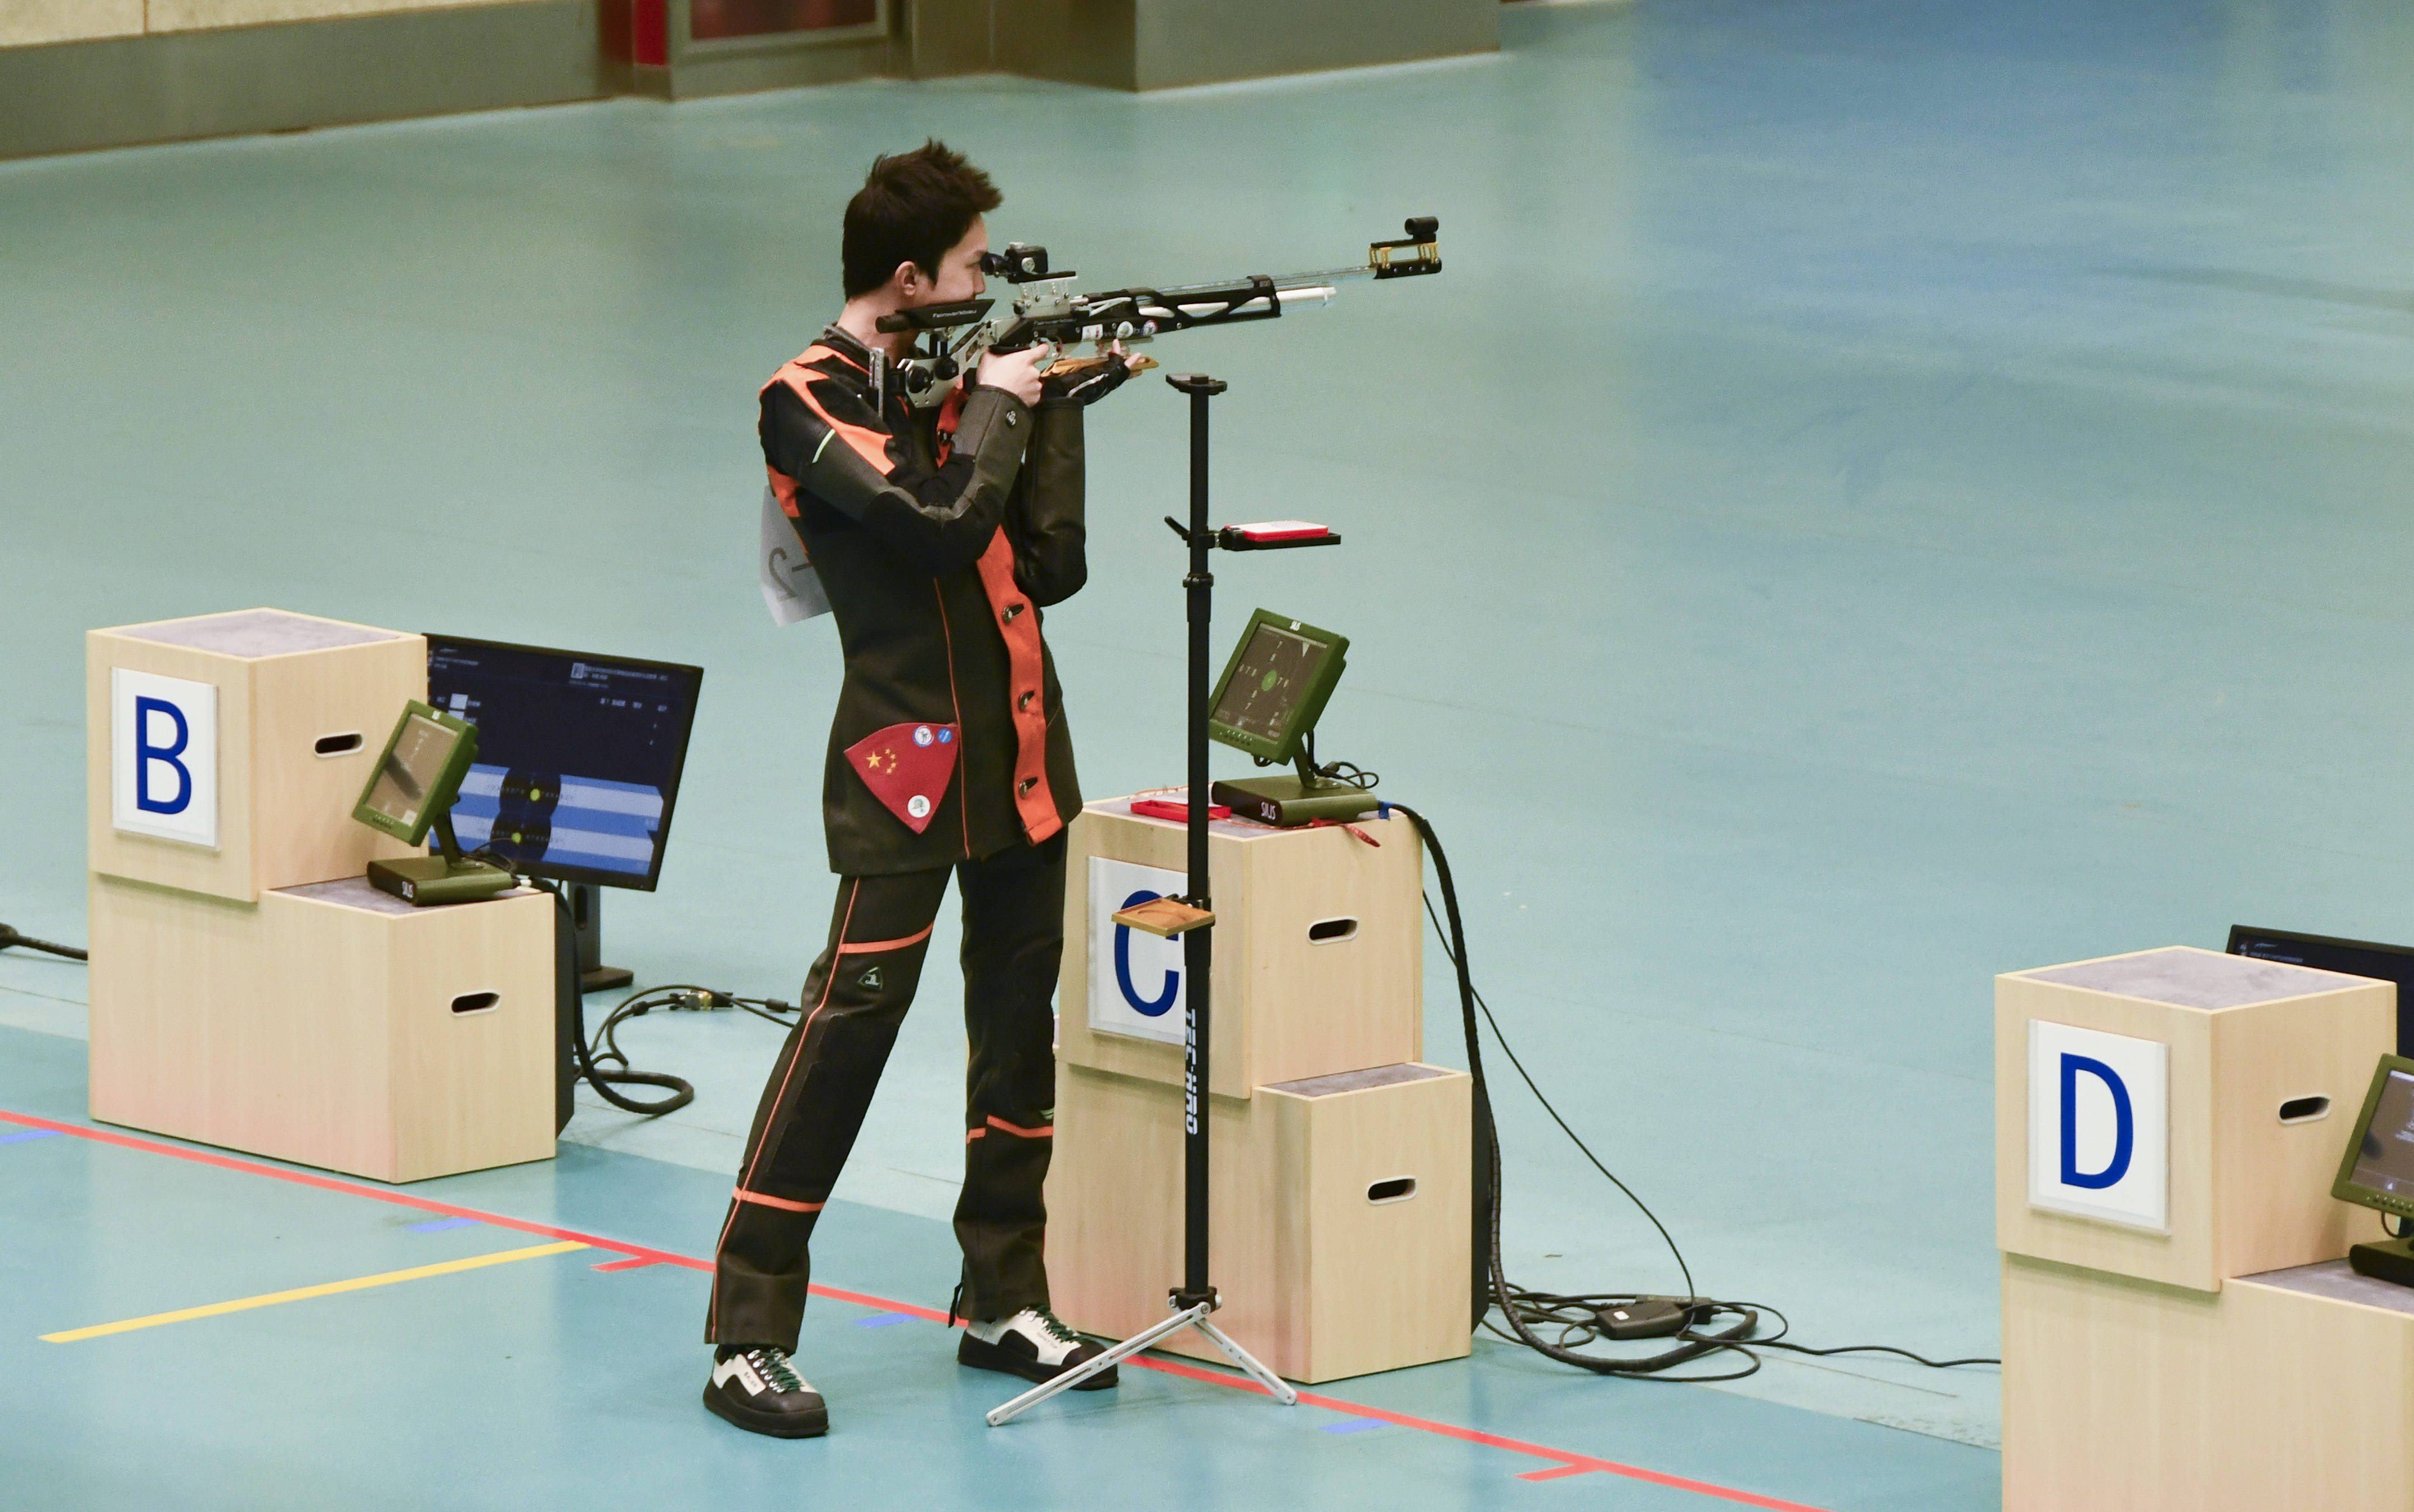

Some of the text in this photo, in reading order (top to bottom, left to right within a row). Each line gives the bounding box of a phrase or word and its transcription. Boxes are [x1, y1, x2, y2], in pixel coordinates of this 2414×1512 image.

[135, 695, 192, 814] B
[1114, 890, 1179, 1017] C
[1186, 1008, 1198, 1135] TEC-HRO
[2060, 1052, 2134, 1190] D
